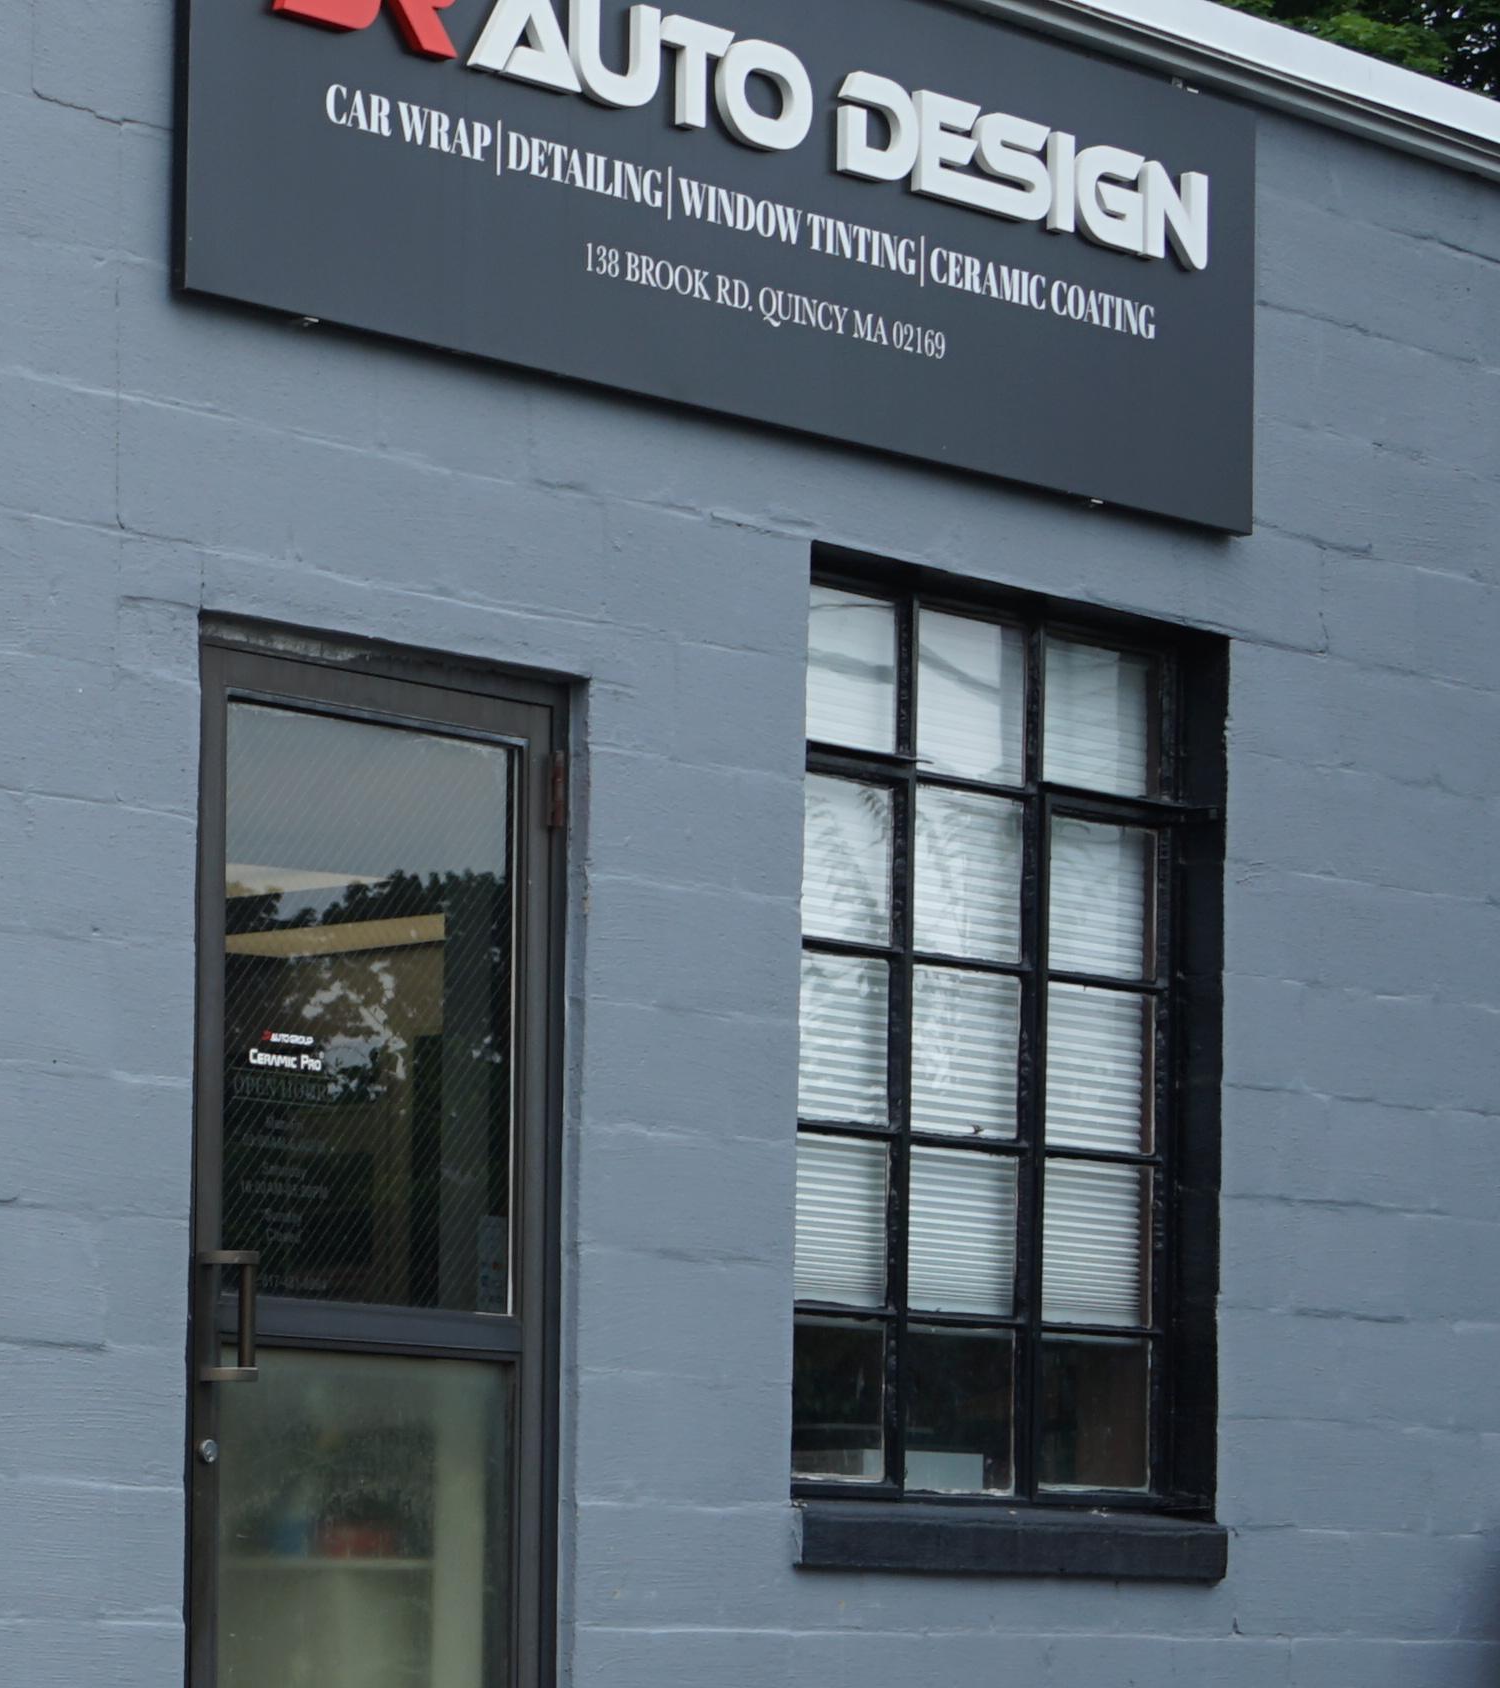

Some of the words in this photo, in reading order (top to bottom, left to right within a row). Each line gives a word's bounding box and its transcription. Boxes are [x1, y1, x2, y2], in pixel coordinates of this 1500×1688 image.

[326, 83, 392, 137] CAR
[397, 101, 492, 162] WRAP
[507, 131, 663, 208] DETAILING
[678, 177, 803, 246] WINDOW
[806, 213, 916, 276] TINTING
[929, 247, 1046, 312] CERAMIC
[1050, 280, 1156, 341] COATING
[466, 0, 813, 151] AUTO
[836, 70, 1209, 271] DESIGN
[586, 242, 620, 278] 138
[625, 251, 711, 302] BROOK
[716, 274, 753, 312] RD.
[758, 287, 849, 335] QUINCY
[852, 310, 889, 346] MA
[892, 323, 946, 361] 02169
[249, 1048, 297, 1068] CERAMIC
